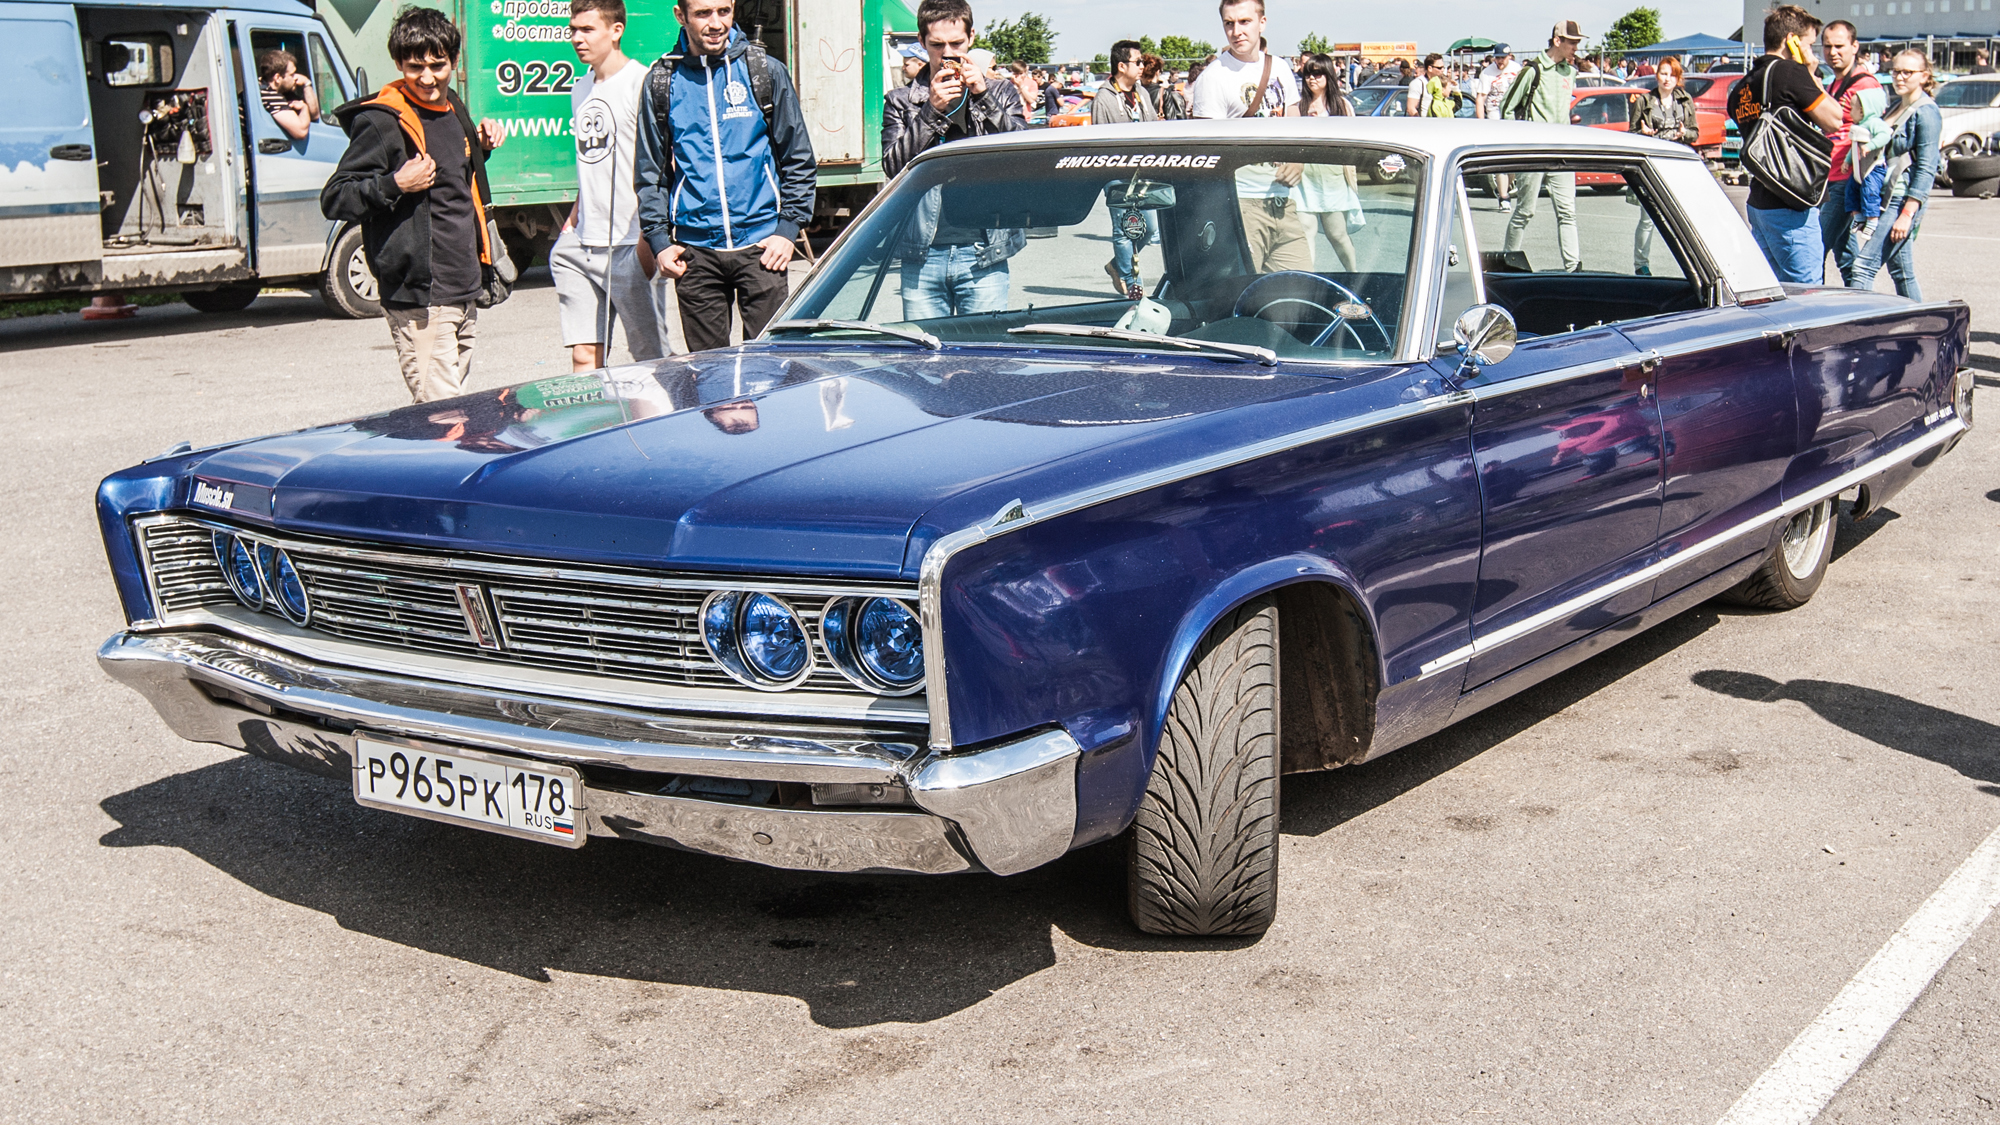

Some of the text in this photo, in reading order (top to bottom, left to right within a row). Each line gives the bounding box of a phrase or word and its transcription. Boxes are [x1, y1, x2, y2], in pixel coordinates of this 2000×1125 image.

[1055, 154, 1221, 169] #MUSCLEGARAGE
[512, 772, 566, 816] 178
[525, 812, 553, 830] RUS
